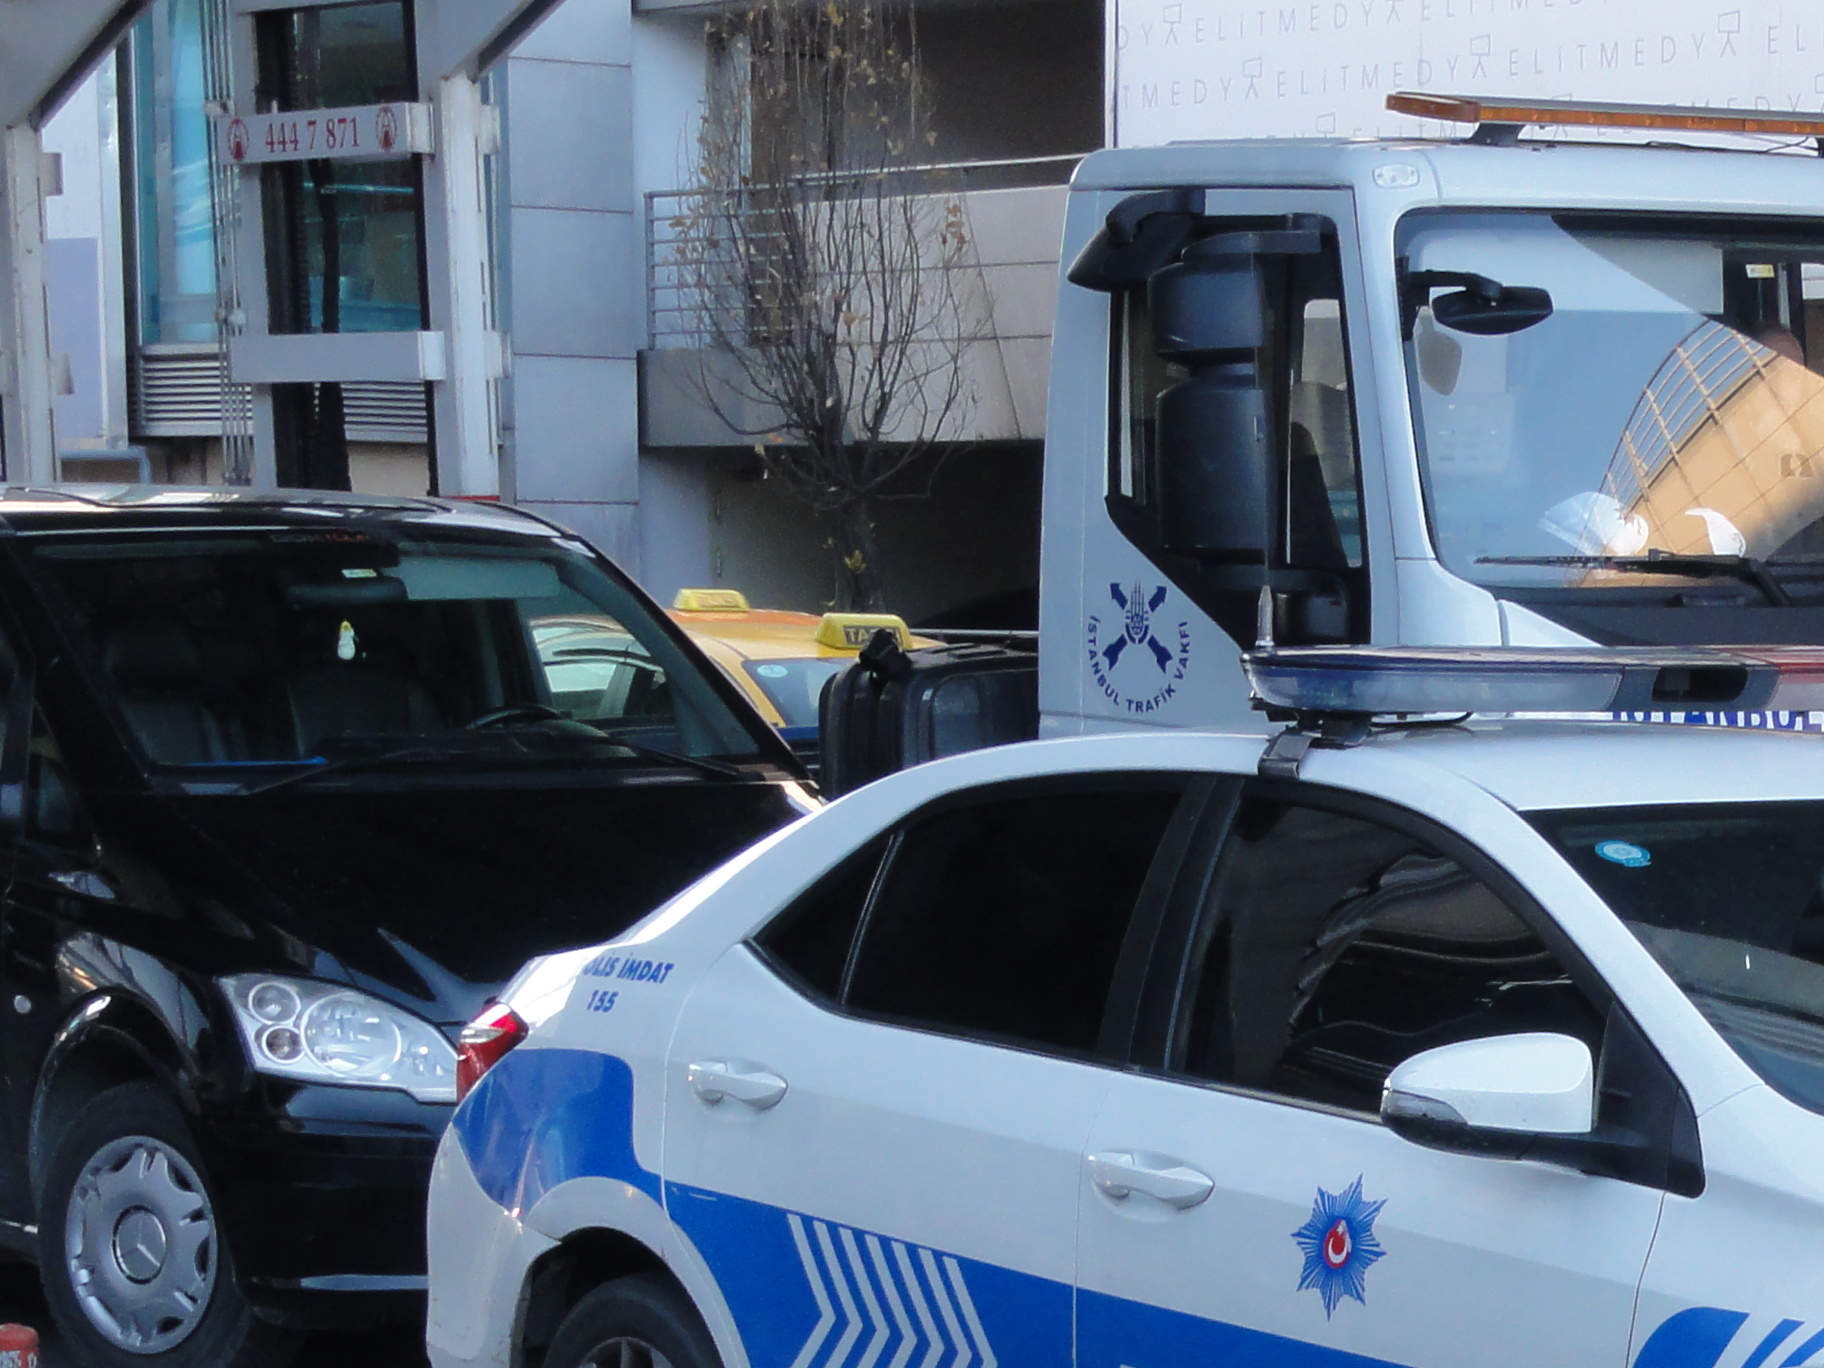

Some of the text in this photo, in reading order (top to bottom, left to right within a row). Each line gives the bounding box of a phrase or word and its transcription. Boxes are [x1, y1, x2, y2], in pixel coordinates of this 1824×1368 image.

[264, 116, 360, 153] 444 7 871
[586, 989, 620, 1013] 155
